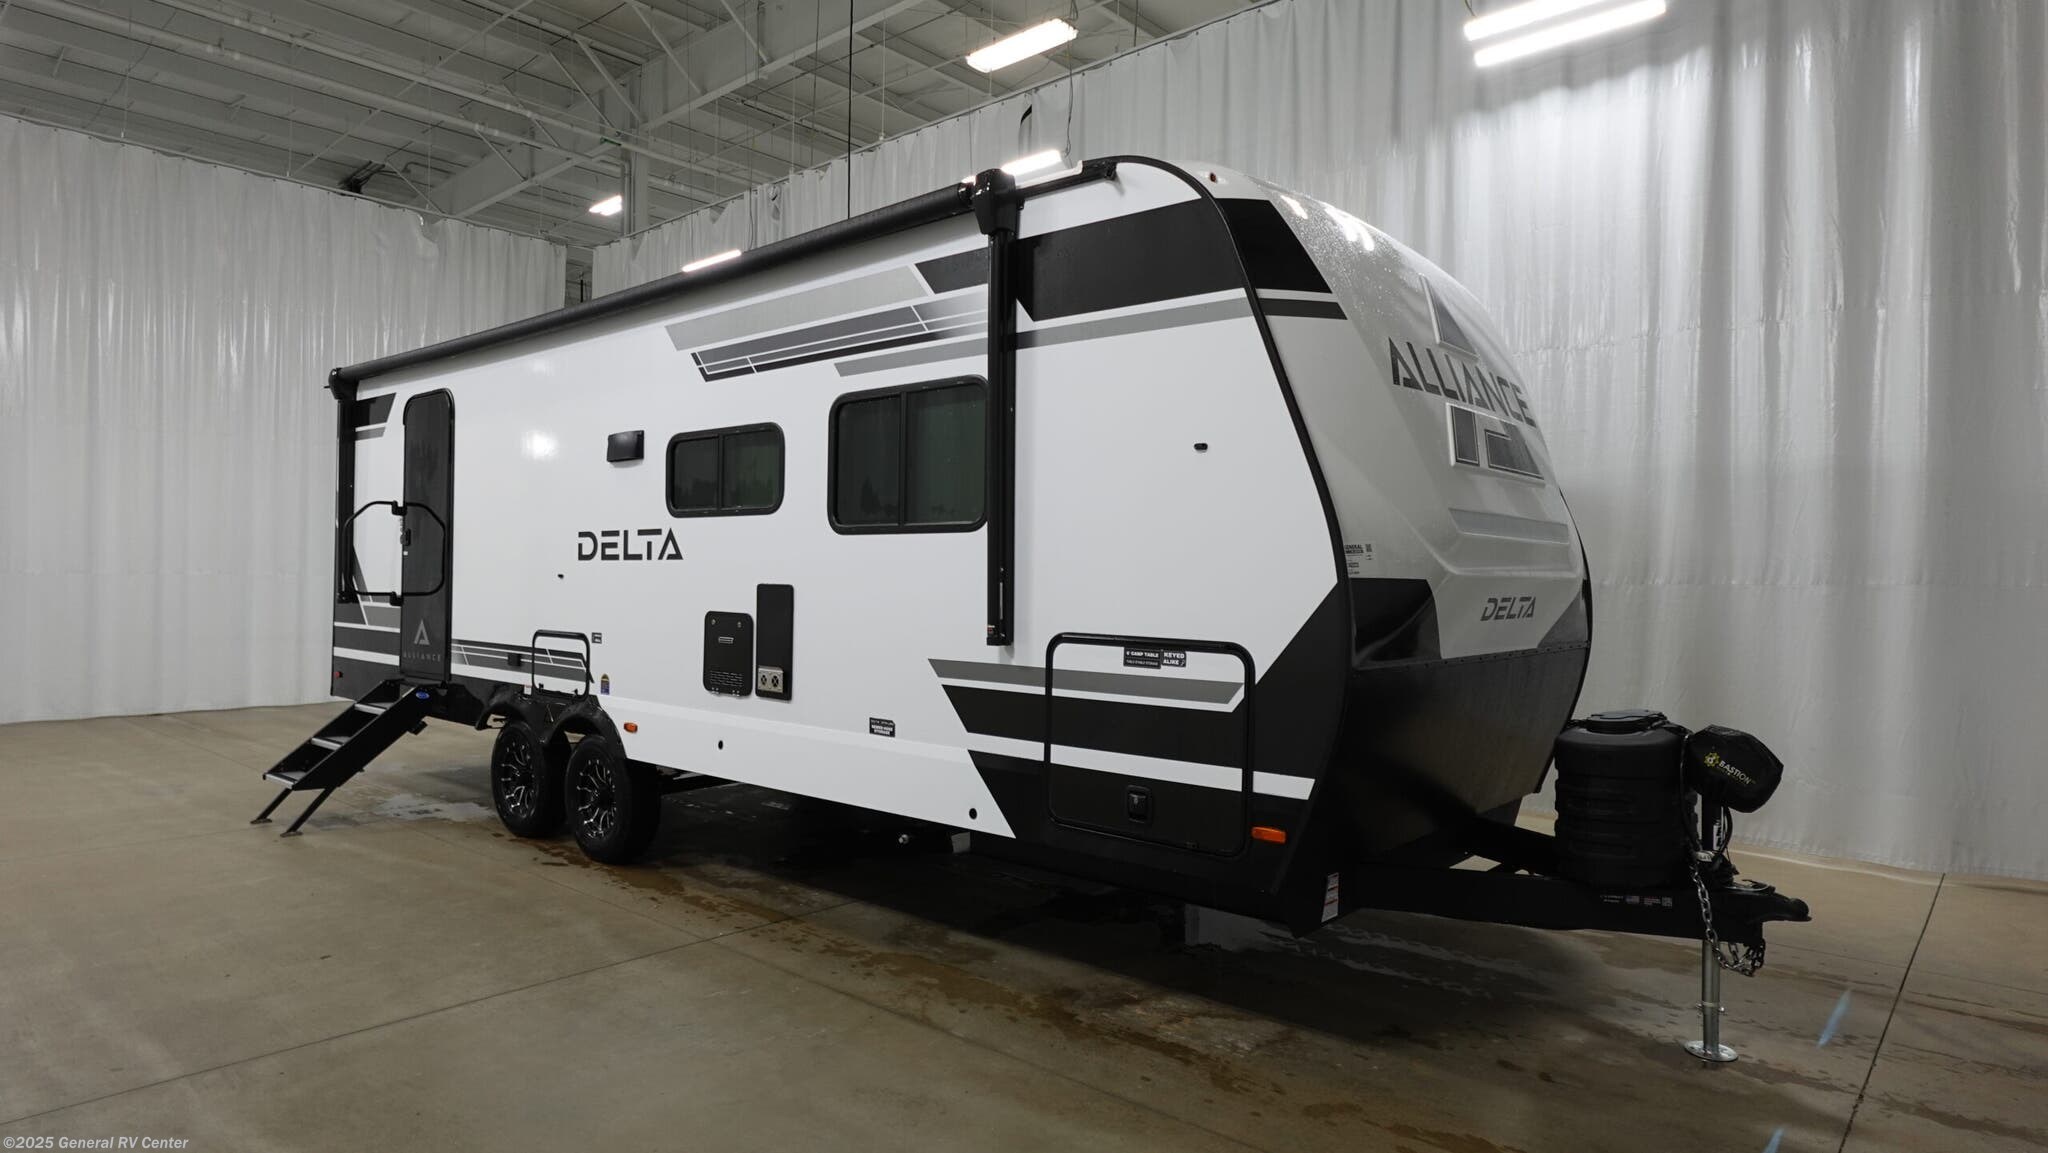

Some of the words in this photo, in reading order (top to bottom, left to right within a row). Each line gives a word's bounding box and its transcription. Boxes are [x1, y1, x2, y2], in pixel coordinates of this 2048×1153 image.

[1388, 336, 1537, 428] ALLIANCE
[578, 527, 684, 561] DELTA
[1480, 596, 1536, 621] DELTA
[1719, 760, 1752, 784] BASTION
